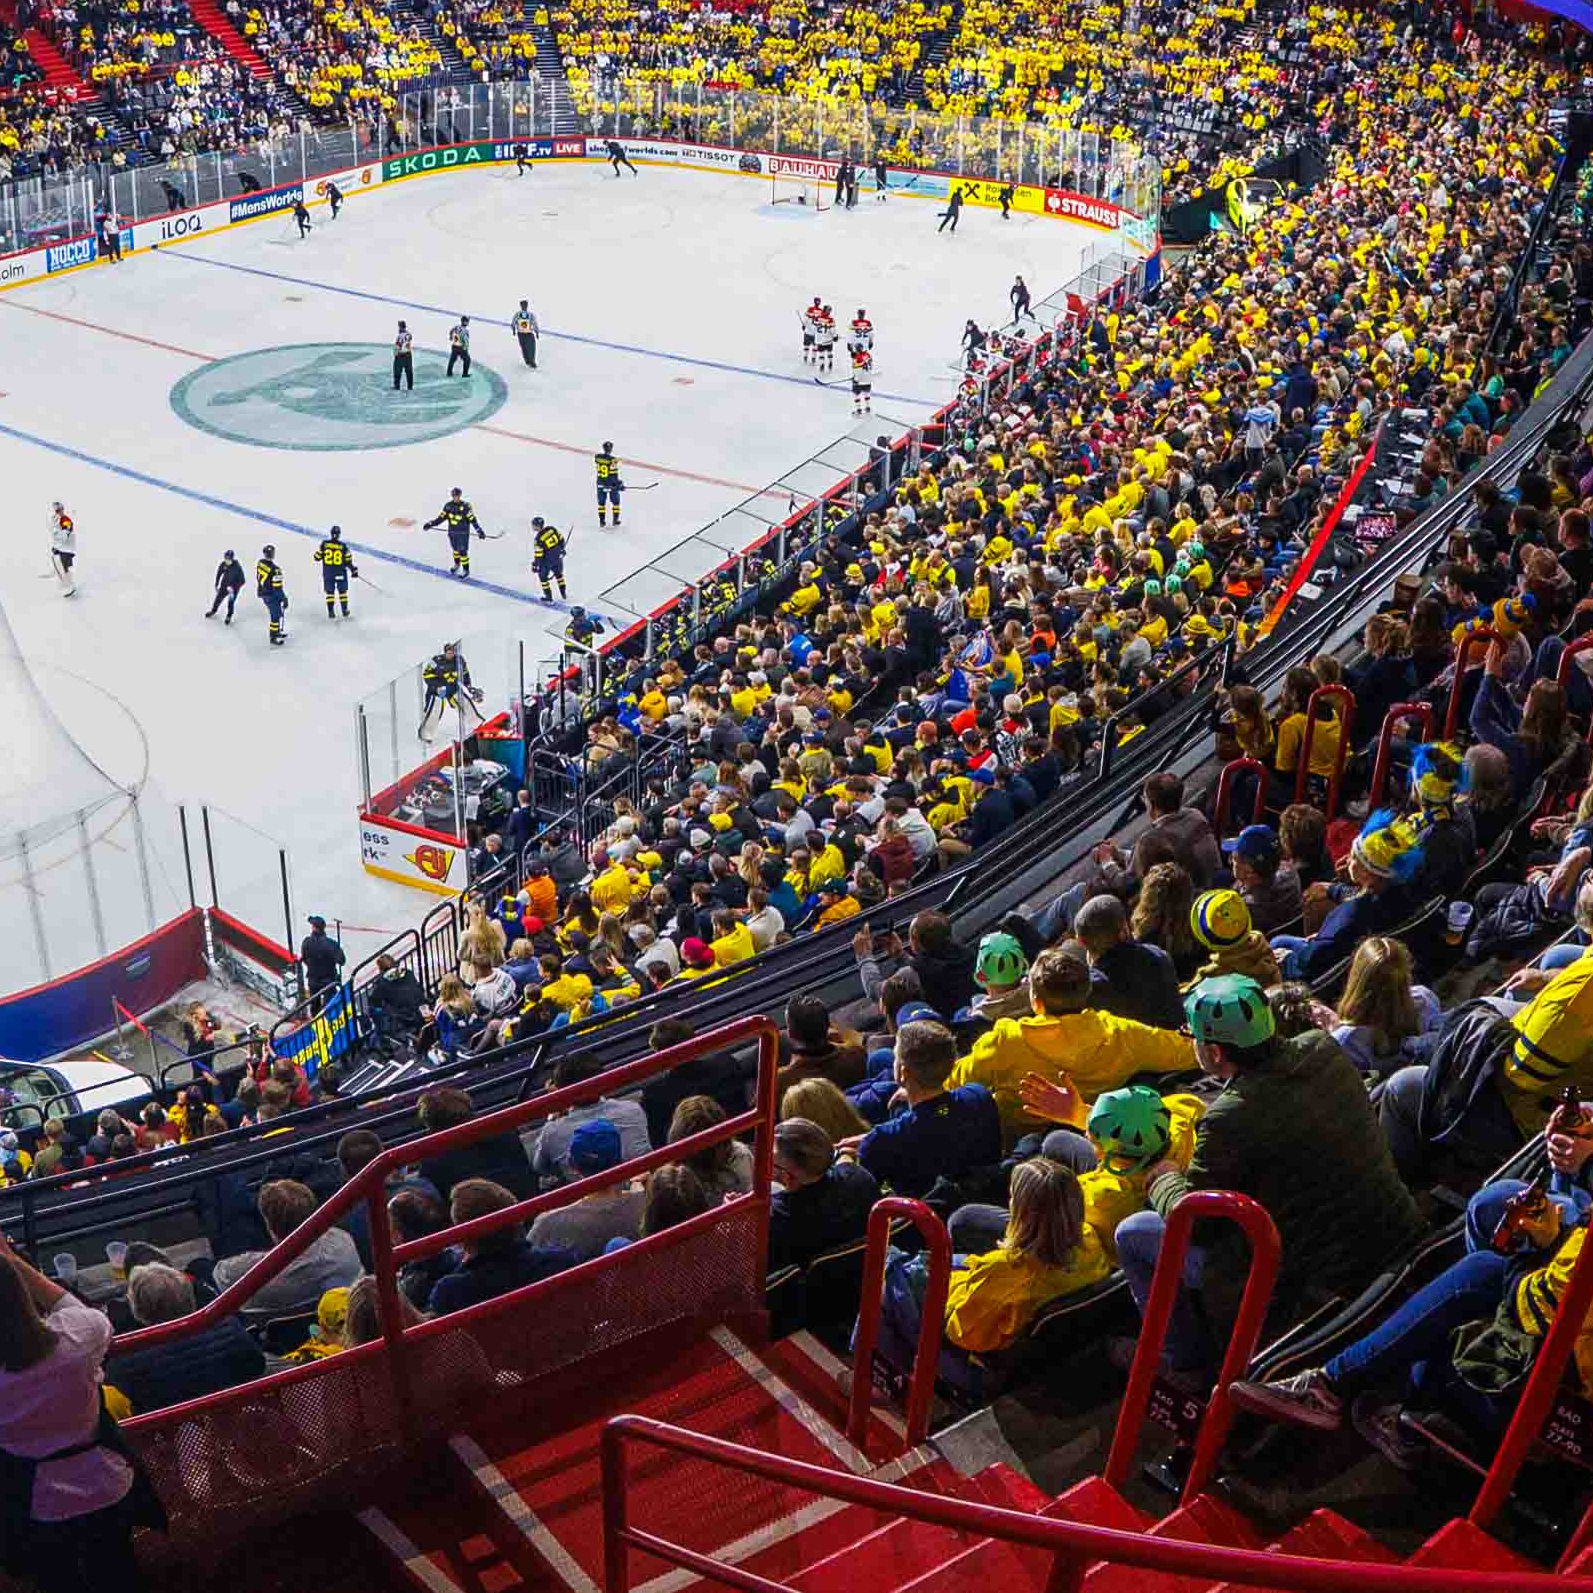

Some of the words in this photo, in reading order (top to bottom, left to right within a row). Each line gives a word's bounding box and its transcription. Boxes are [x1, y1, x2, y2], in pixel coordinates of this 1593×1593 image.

[556, 143, 581, 154] LIVE
[697, 151, 735, 163] TISSOT
[770, 158, 838, 181] BAUHAU
[231, 189, 303, 219] #MensWorlds
[1062, 198, 1117, 226] STRAUSS
[161, 214, 202, 239] iLOQ
[50, 239, 90, 266] NOCCO
[324, 549, 343, 566] 28
[1182, 1400, 1199, 1419] 5
